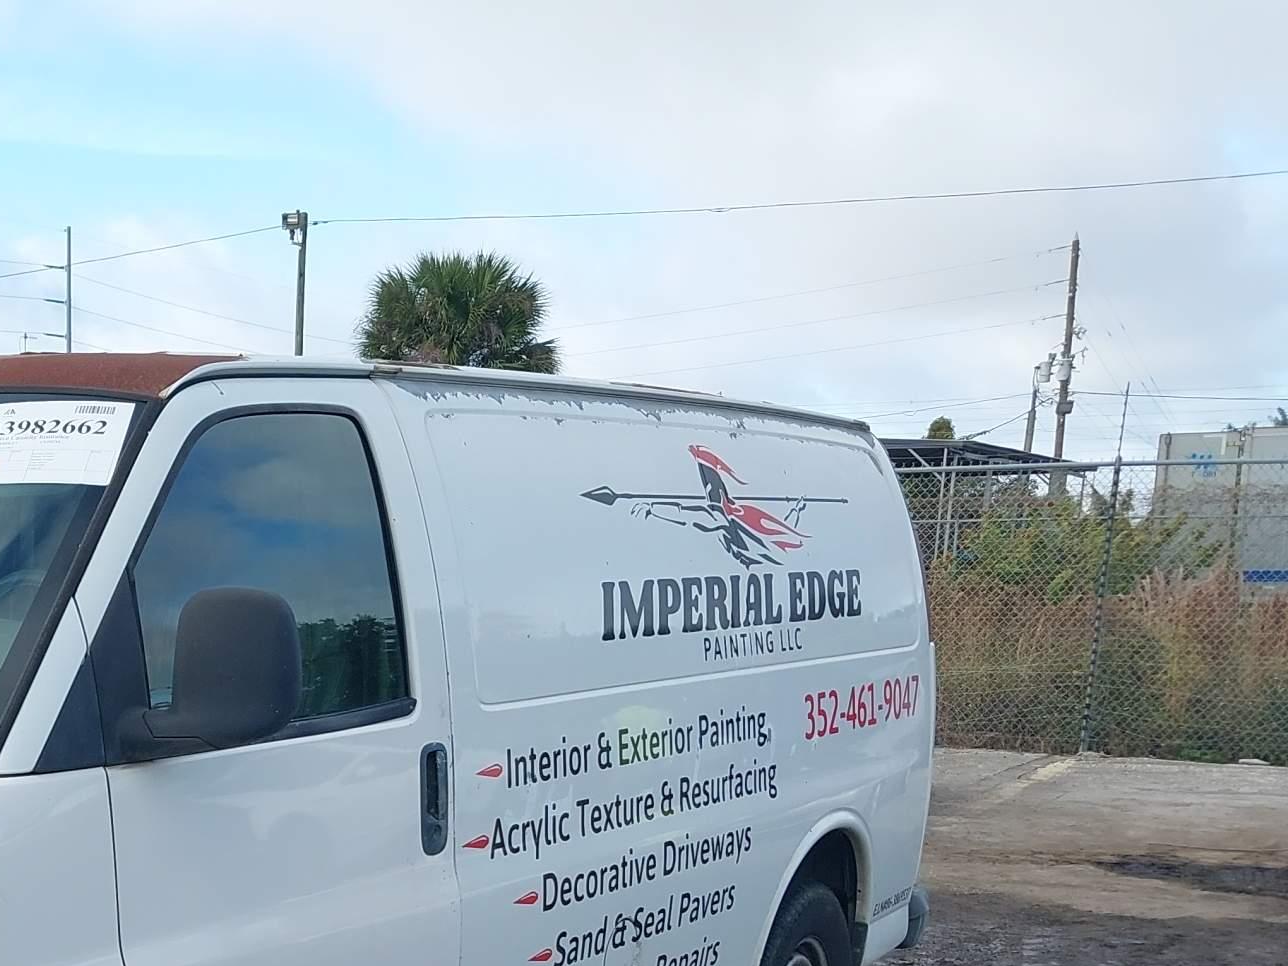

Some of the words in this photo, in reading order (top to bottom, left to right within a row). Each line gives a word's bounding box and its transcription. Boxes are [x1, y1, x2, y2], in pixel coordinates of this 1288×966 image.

[601, 572, 783, 641] IMPERIAL
[789, 569, 862, 621] EDGE
[703, 630, 774, 661] PAINTING
[780, 628, 803, 653] LLC
[803, 675, 920, 741] 352-461-9047
[507, 736, 591, 788] Interior
[598, 732, 613, 770] &
[618, 718, 693, 766] Exterior
[490, 803, 570, 860] Acrylic
[575, 793, 654, 837] Texture
[661, 781, 674, 816] &
[679, 759, 778, 812] Resurfacing
[543, 848, 656, 912] Decorative
[663, 826, 751, 876] Driveways
[612, 913, 627, 949] &
[631, 895, 673, 943] Seal
[678, 885, 735, 927] Pavers
